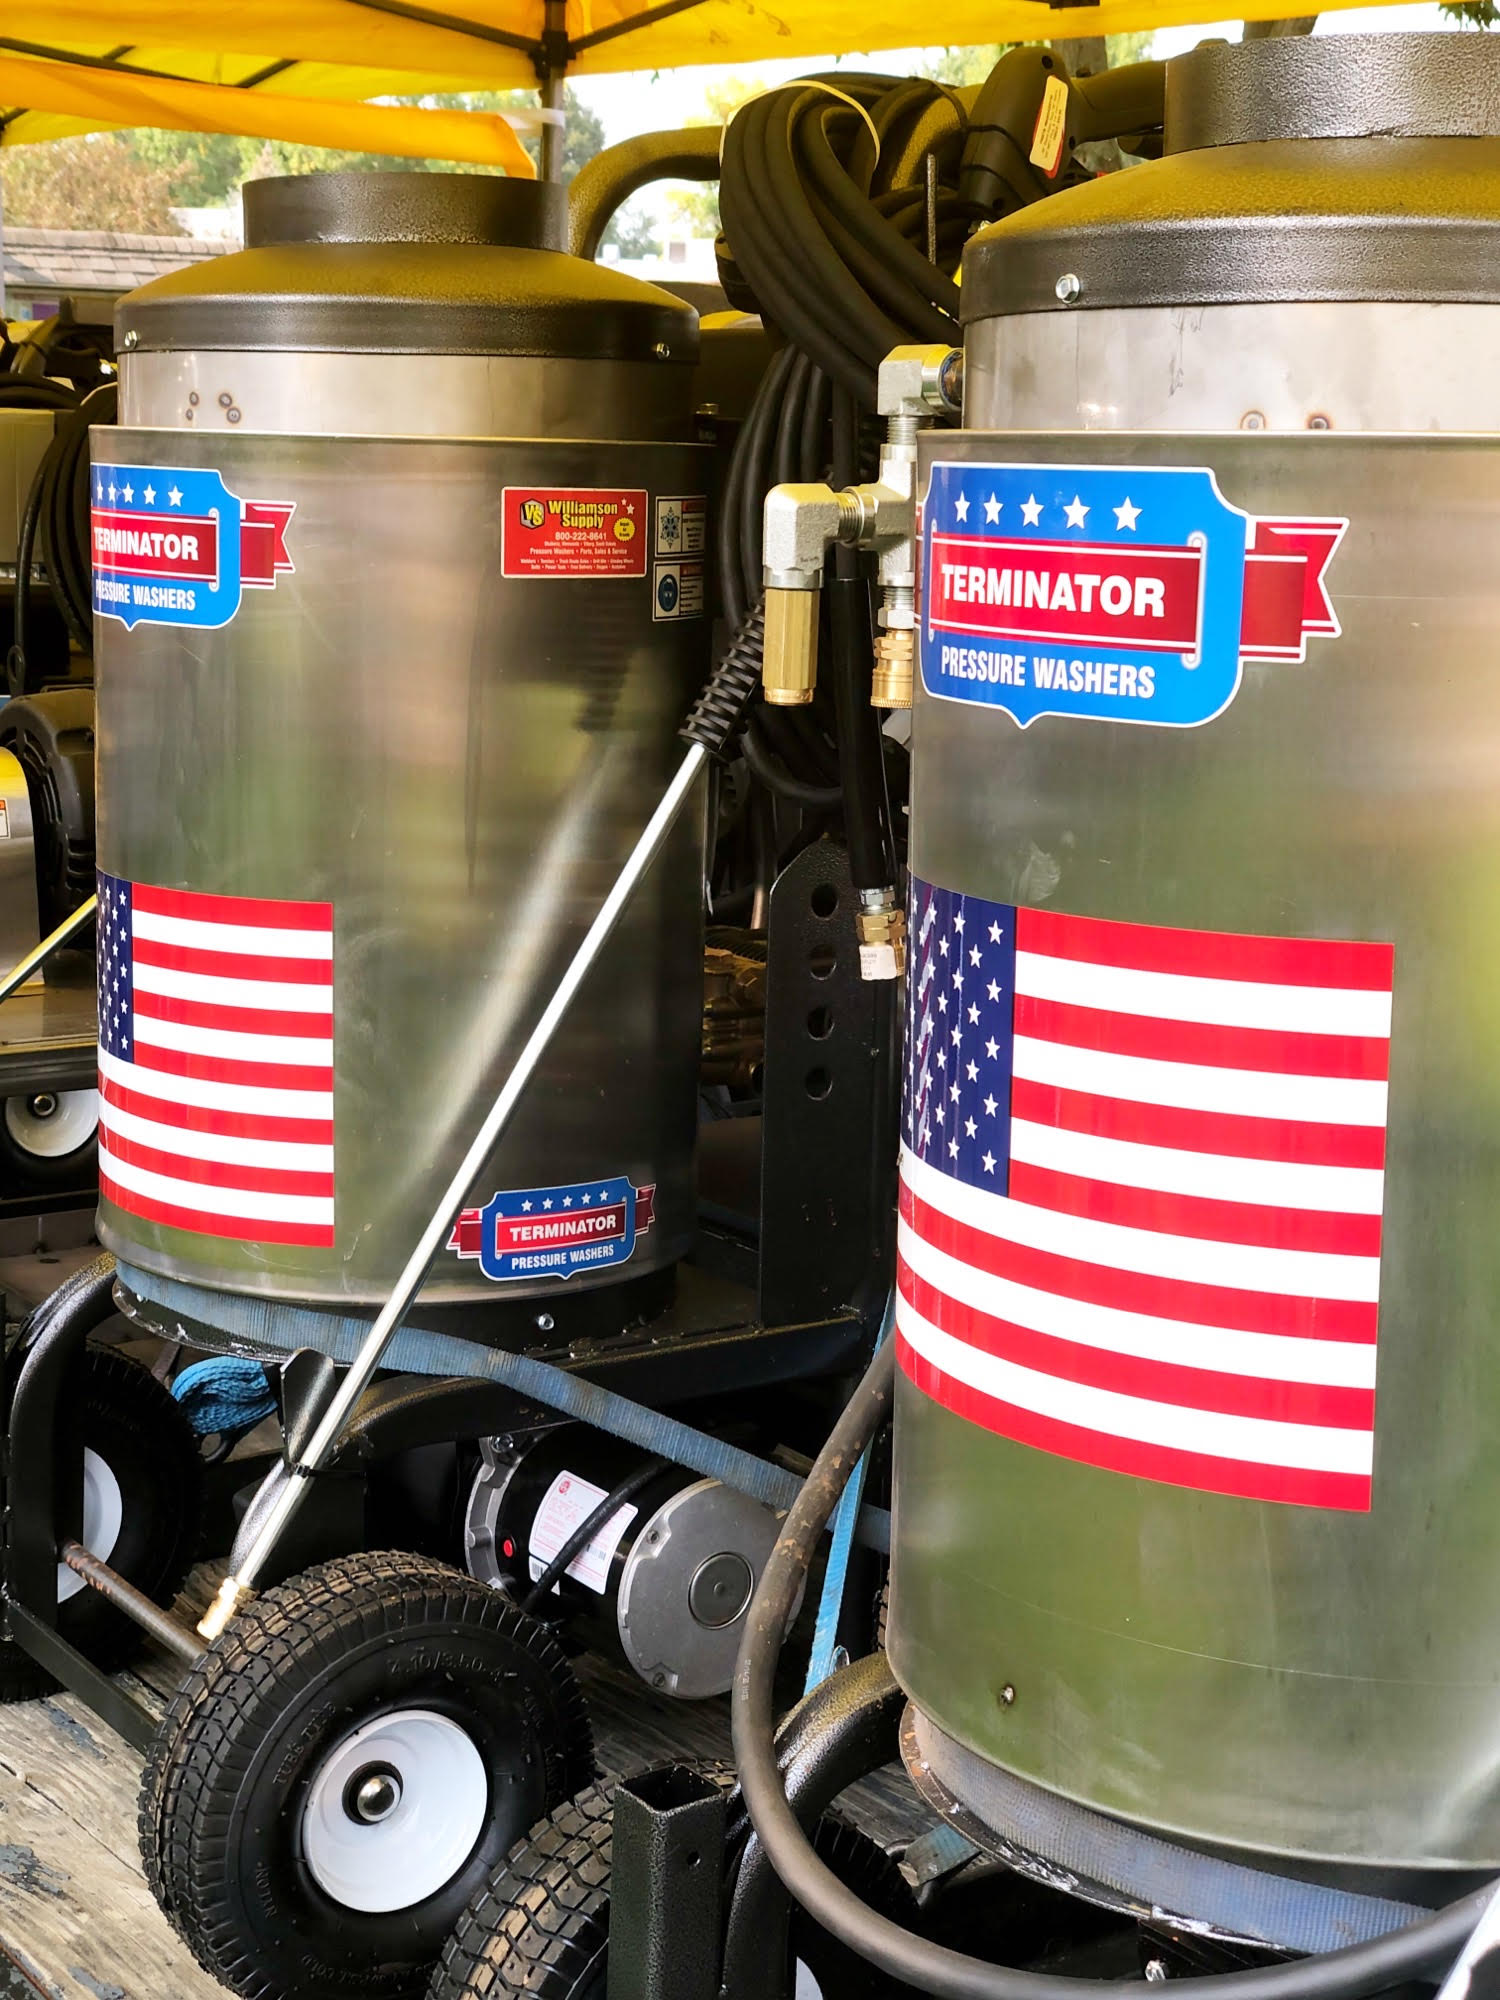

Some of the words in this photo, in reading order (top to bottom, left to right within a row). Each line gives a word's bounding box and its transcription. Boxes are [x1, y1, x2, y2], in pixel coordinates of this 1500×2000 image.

[548, 500, 618, 514] Williamson
[561, 514, 604, 528] Supply
[94, 526, 199, 561] TERMINATOR
[133, 584, 196, 611] WASHERS
[941, 564, 1166, 618] TERMINATOR
[941, 645, 1026, 687] PRESSURE
[1033, 656, 1155, 699] WASHERS
[509, 1214, 616, 1242] TERMINATOR
[511, 1252, 567, 1270] PRESSURE
[570, 1244, 614, 1263] WASHERS
